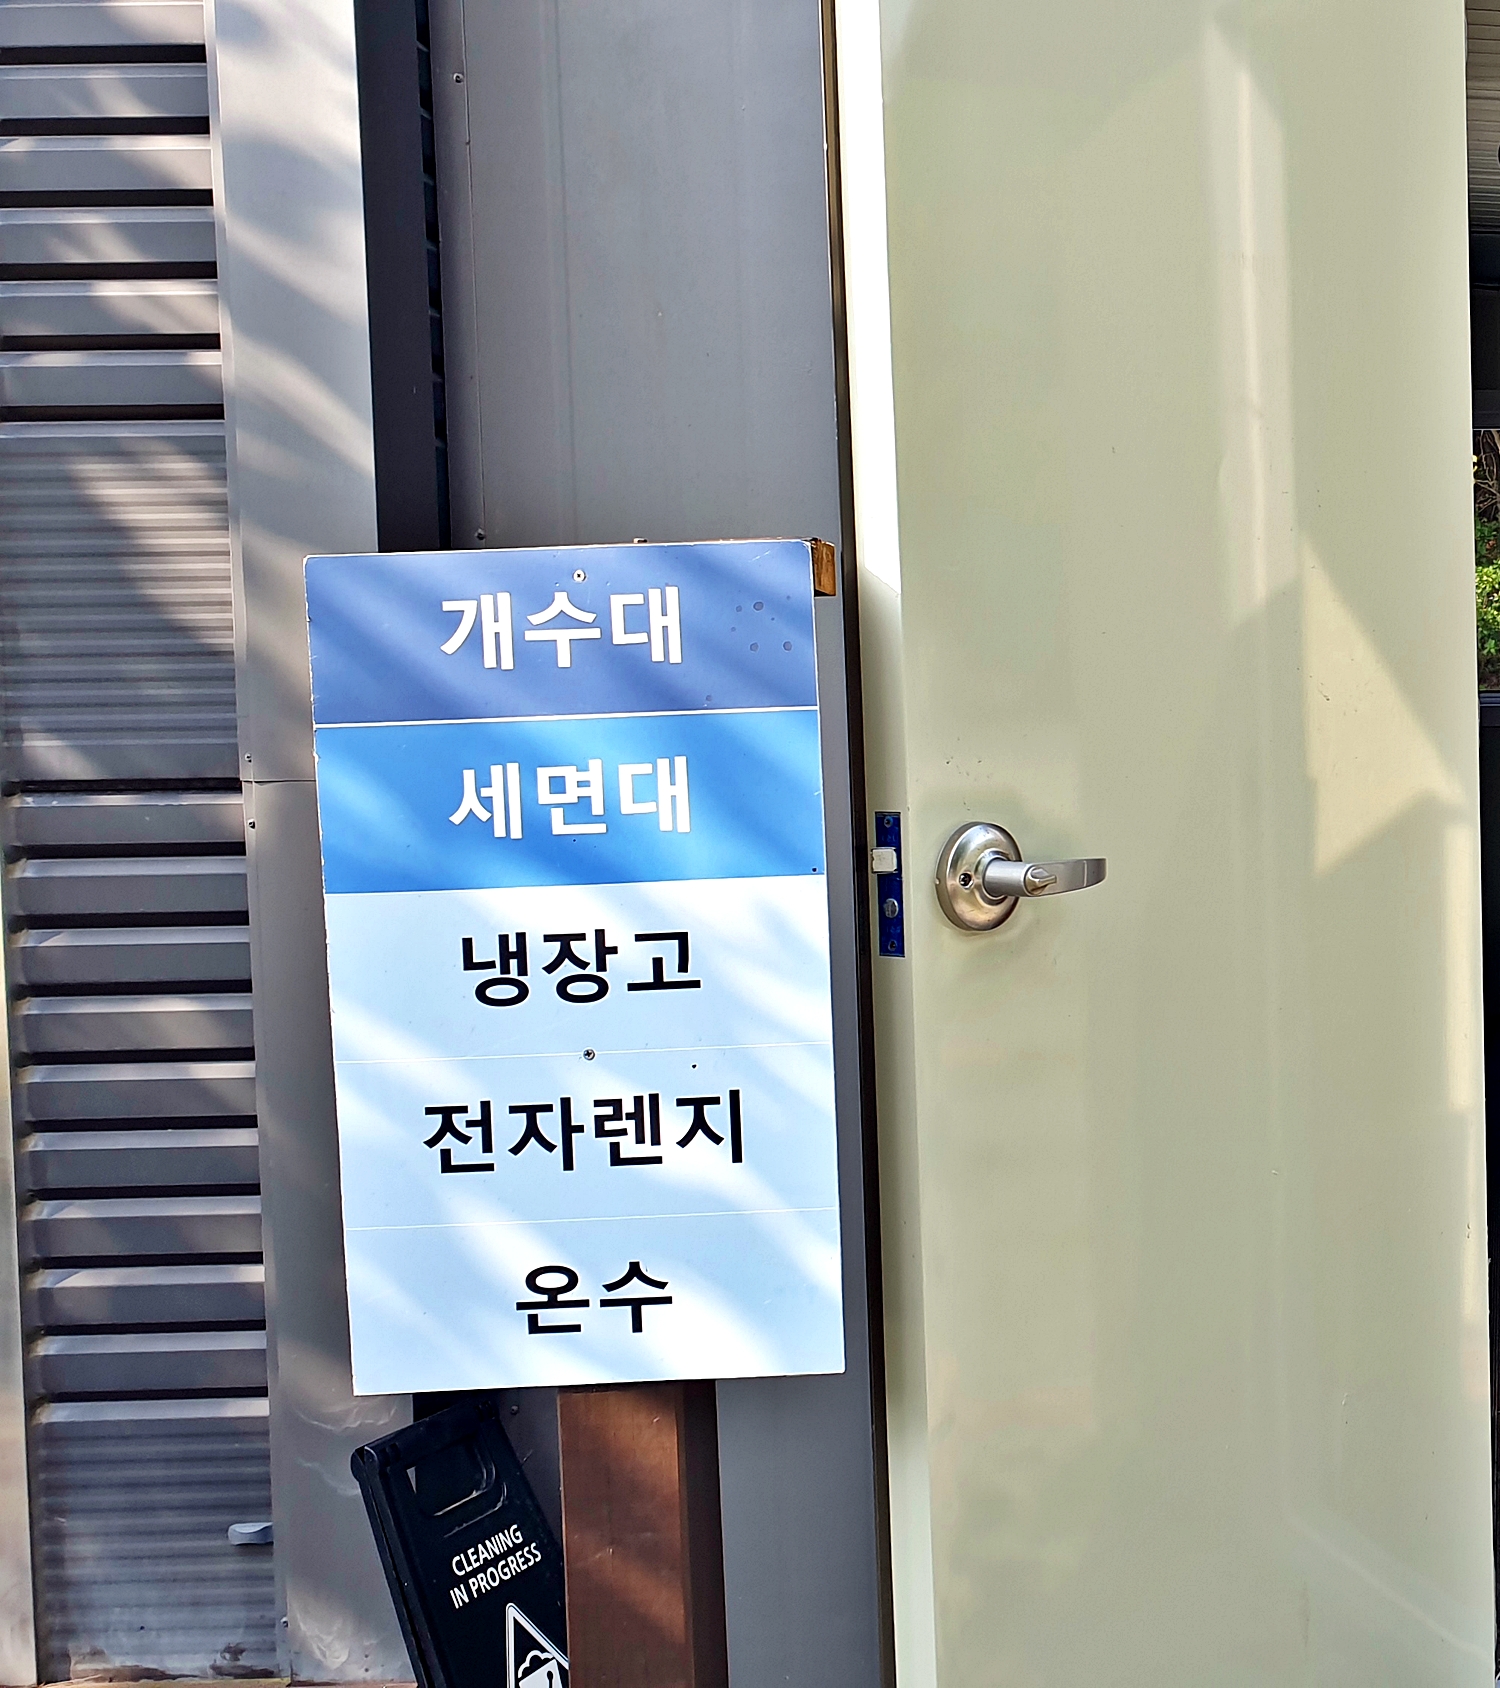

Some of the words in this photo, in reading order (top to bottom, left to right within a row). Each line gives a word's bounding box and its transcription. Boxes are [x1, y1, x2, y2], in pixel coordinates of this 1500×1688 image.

[440, 585, 683, 671] 개수대
[448, 755, 692, 840] 세면대
[461, 928, 702, 1007] 냉장고
[422, 1089, 744, 1174] 전자렌지
[515, 1261, 673, 1335] 온수
[449, 1583, 469, 1609] IN
[468, 1542, 541, 1598] PROGRESS
[452, 1524, 523, 1576] CLEANING
